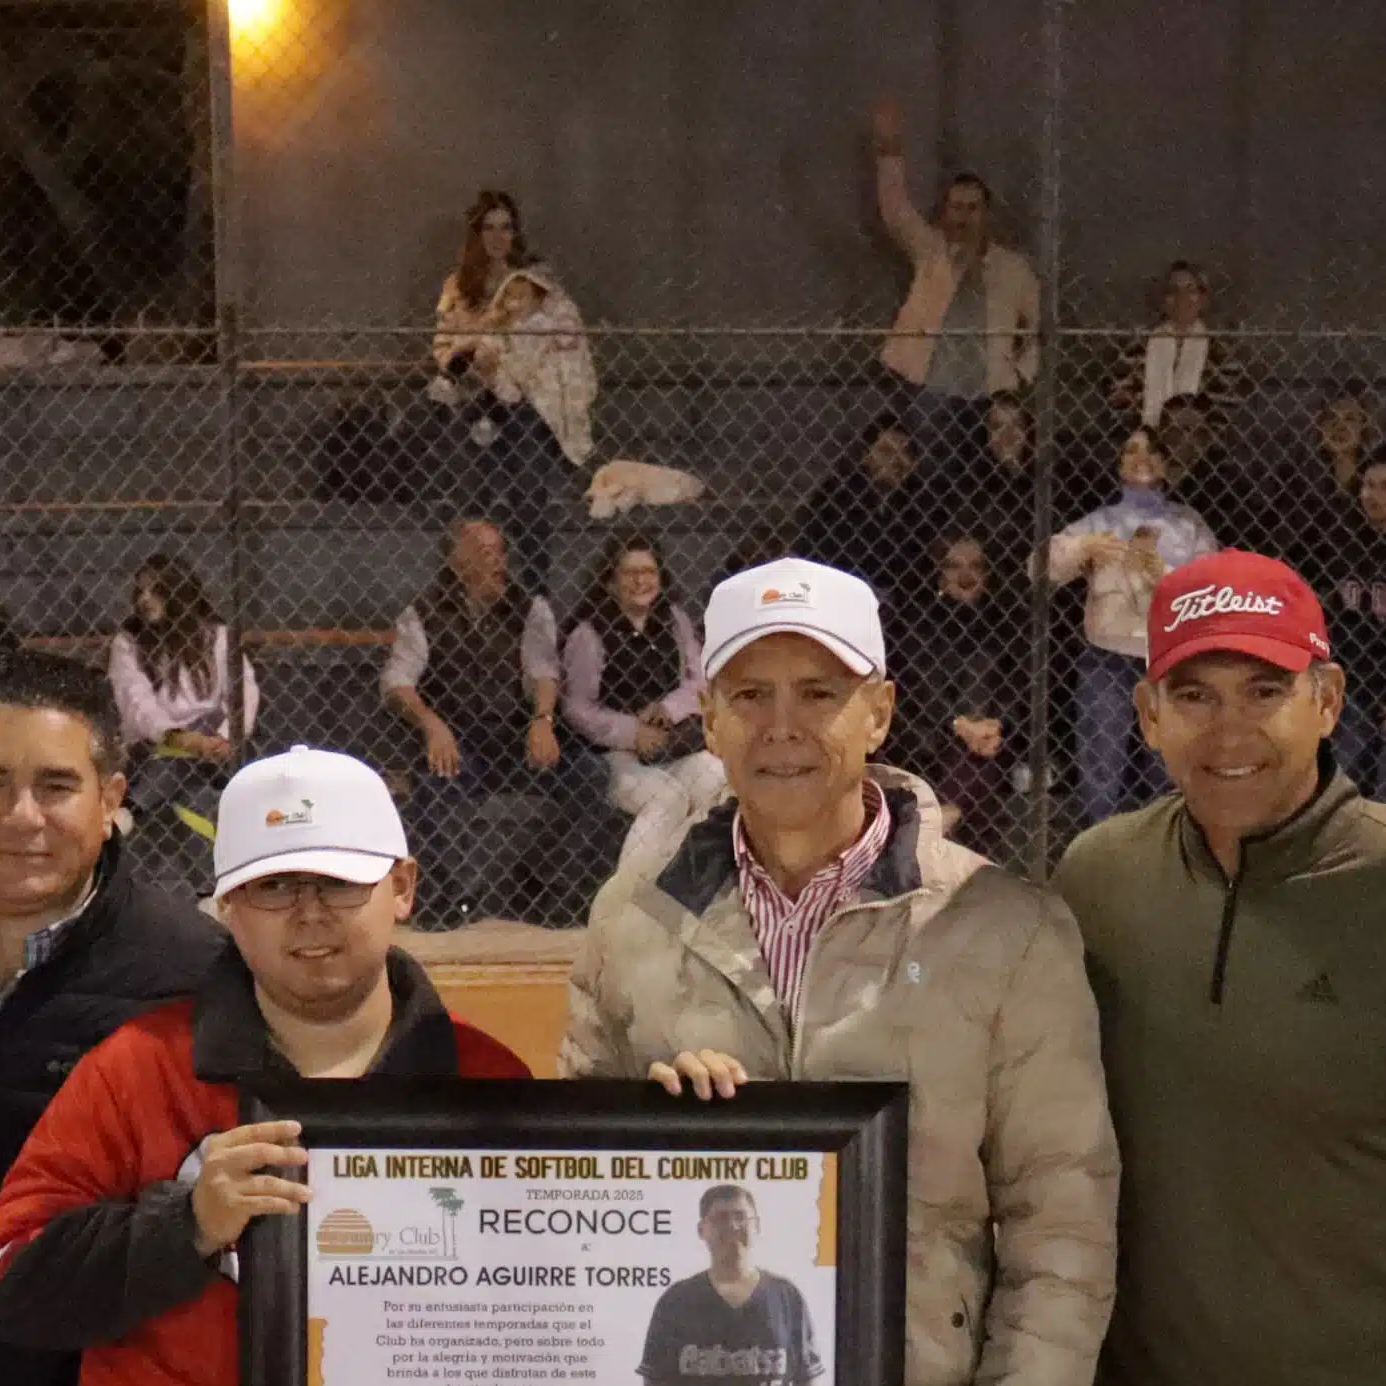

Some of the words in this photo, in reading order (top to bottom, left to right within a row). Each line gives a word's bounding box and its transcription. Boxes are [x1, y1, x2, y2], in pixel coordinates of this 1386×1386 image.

[1164, 584, 1284, 632] Titleist
[333, 1155, 379, 1179] LIGA
[385, 1155, 473, 1179] INTERNA
[480, 1156, 507, 1179] DE
[514, 1156, 605, 1180] SOFTBOL
[611, 1156, 652, 1180] DEL
[657, 1156, 750, 1180] COUNTRY
[756, 1157, 809, 1180] CLUB
[525, 1189, 610, 1201] TEMPORADA
[479, 1209, 672, 1235] RECONOCE
[399, 1226, 441, 1245] Club
[329, 1266, 469, 1287] ALEJANDRO
[476, 1266, 576, 1287] AGUIRRE
[585, 1266, 672, 1287] TORRES
[383, 1301, 405, 1312] Por
[408, 1304, 422, 1312] su
[425, 1302, 489, 1313] entusiasta
[491, 1301, 576, 1315] participación
[578, 1304, 594, 1313] en
[386, 1318, 404, 1329] las
[407, 1318, 471, 1329] diferentes
[473, 1318, 549, 1332] temporadas
[552, 1321, 577, 1332] que
[579, 1319, 592, 1330] el
[375, 1335, 407, 1347] Club
[410, 1335, 425, 1347] ha
[504, 1337, 534, 1350] pero
[537, 1336, 573, 1347] sobre
[576, 1336, 606, 1347] todo
[392, 1353, 414, 1365] por
[418, 1352, 429, 1363] la
[432, 1351, 477, 1365] alegría
[481, 1354, 488, 1366] y
[492, 1352, 561, 1363] motivación
[564, 1354, 588, 1365] que
[387, 1368, 429, 1378] brinda
[432, 1370, 440, 1378] a
[443, 1368, 461, 1378] los
[464, 1370, 488, 1381] que
[492, 1368, 548, 1378] disfrutan
[551, 1368, 566, 1378] de
[570, 1369, 596, 1378] este
